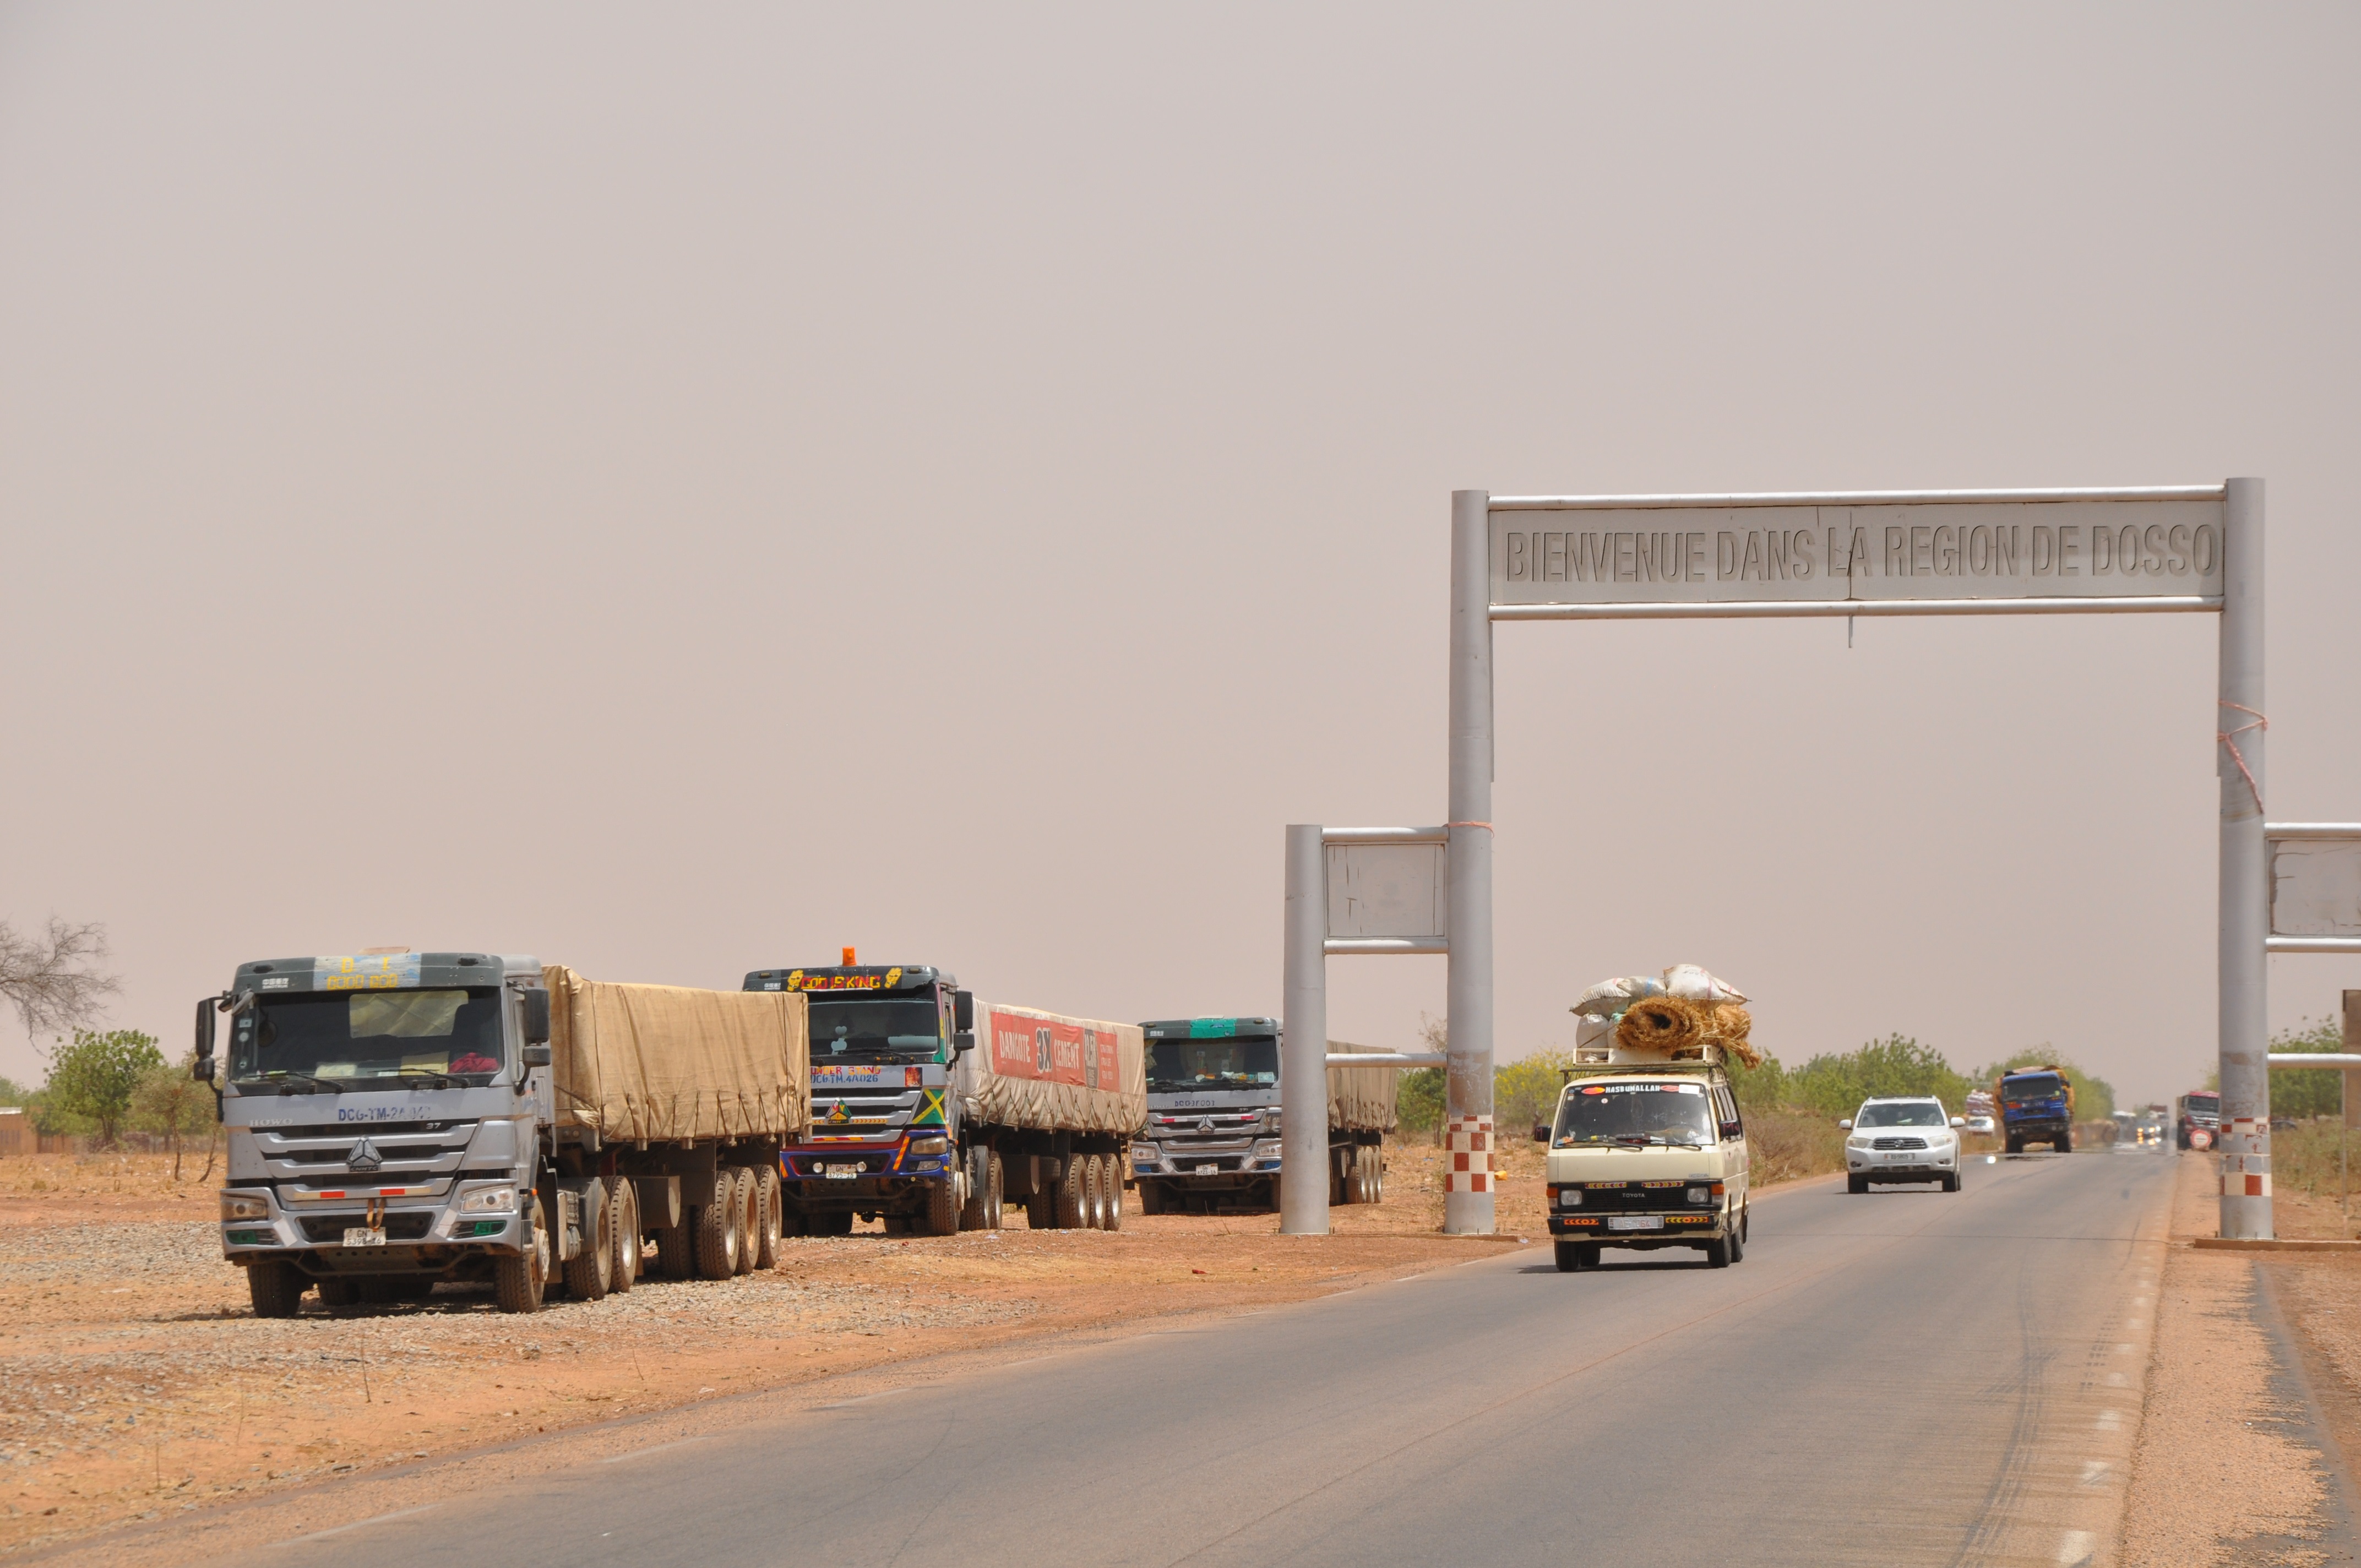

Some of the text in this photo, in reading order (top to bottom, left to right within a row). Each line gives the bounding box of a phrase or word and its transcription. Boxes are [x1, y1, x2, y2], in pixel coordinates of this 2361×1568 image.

[1507, 524, 2219, 583] BIENVENUE DANS LA REGION DE DOSSO
[327, 973, 398, 990] GOOD GOD
[801, 975, 881, 989] GOD IS KING
[999, 1030, 1031, 1063] DANGOTE
[1036, 1027, 1052, 1073] 3X
[1054, 1038, 1080, 1070] CEMENT
[810, 1065, 881, 1075] UNDER STAND
[1605, 1085, 1660, 1093] HASBUNALLAH
